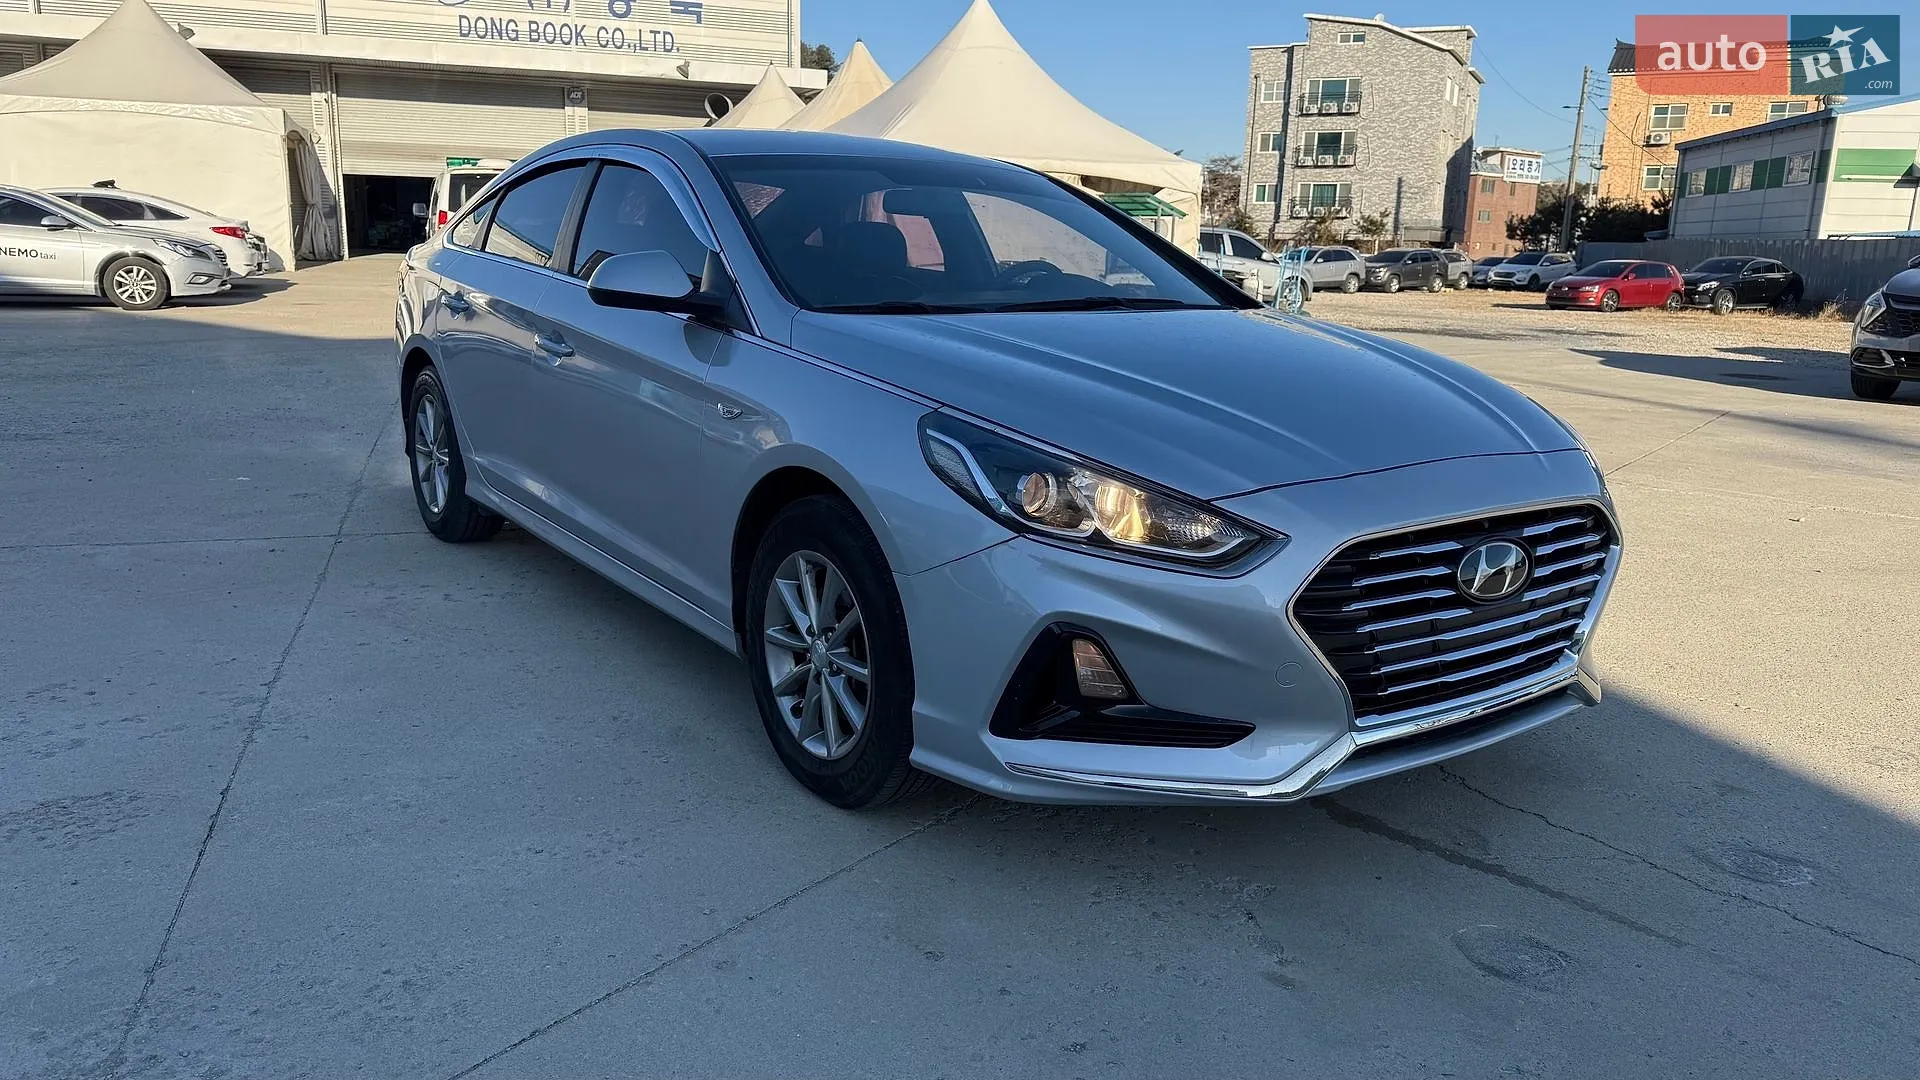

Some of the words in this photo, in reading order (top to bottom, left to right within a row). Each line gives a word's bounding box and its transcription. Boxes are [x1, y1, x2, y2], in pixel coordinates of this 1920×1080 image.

[458, 14, 519, 42] DONG
[528, 20, 587, 46] BOOK
[0, 246, 38, 258] NEMO
[40, 252, 57, 260] taxi
